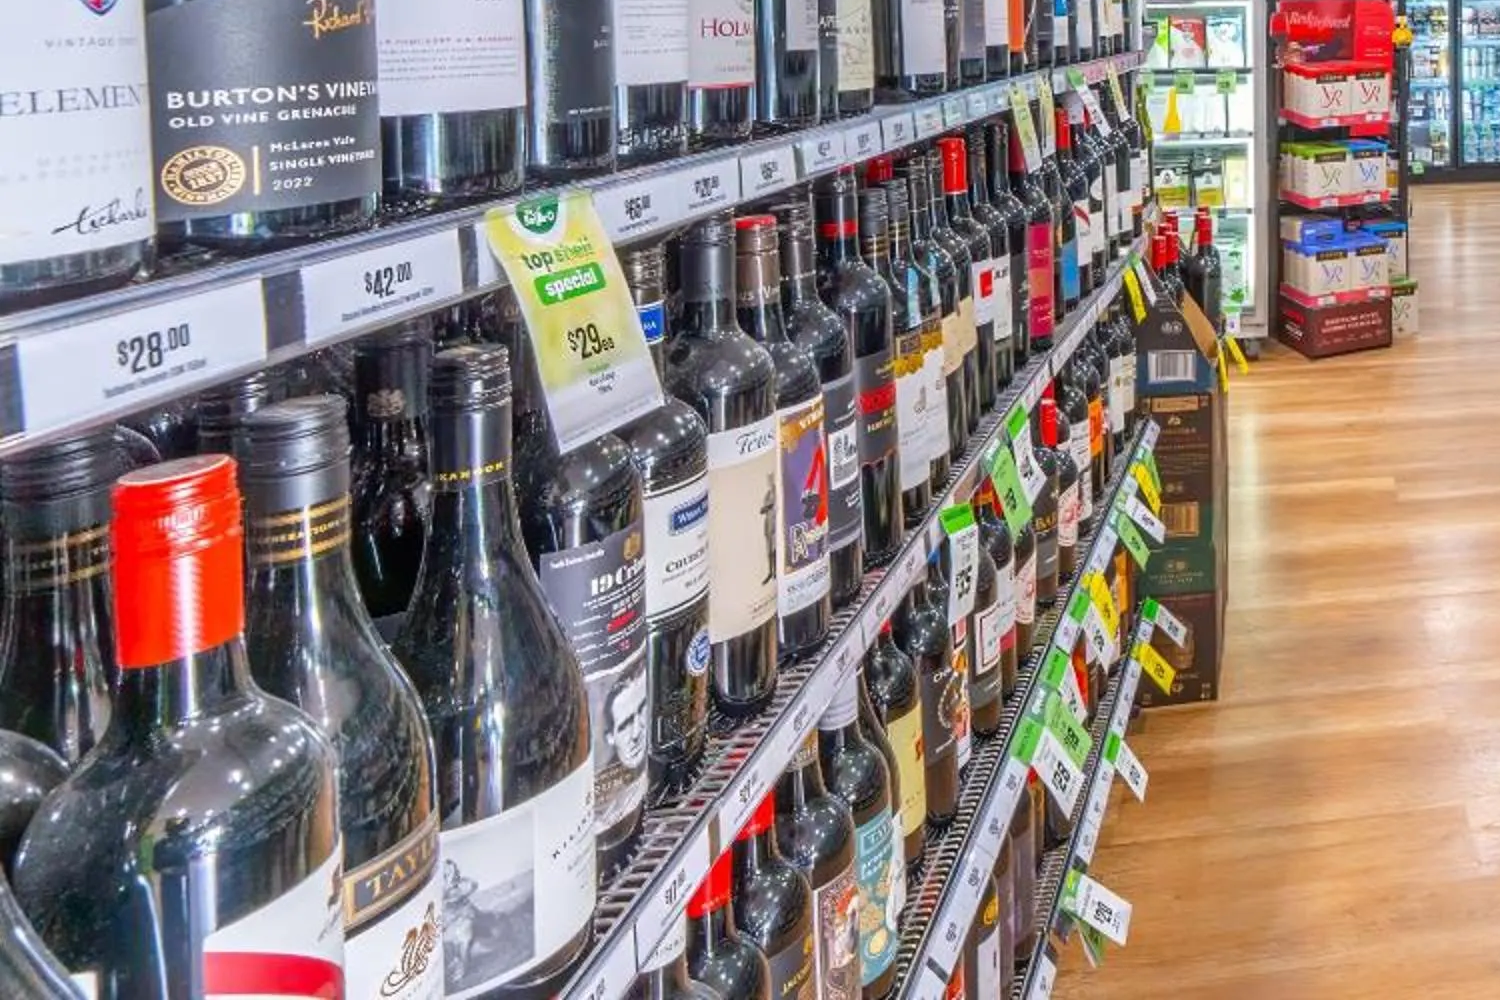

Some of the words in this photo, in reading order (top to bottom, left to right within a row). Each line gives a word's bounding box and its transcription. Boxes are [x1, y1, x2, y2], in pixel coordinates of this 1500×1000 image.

[0, 85, 144, 117] ELEMEN
[167, 83, 318, 110] BURTON'S
[325, 80, 376, 101] VINEY
[168, 113, 213, 129] OLD
[219, 111, 268, 126] VINE
[277, 103, 357, 122] GRENACHE
[269, 157, 324, 171] SINGLE
[272, 178, 312, 191] 2022
[521, 252, 554, 273] top
[364, 261, 412, 299] $42.00
[544, 268, 599, 300] special
[117, 322, 191, 375] $28.00
